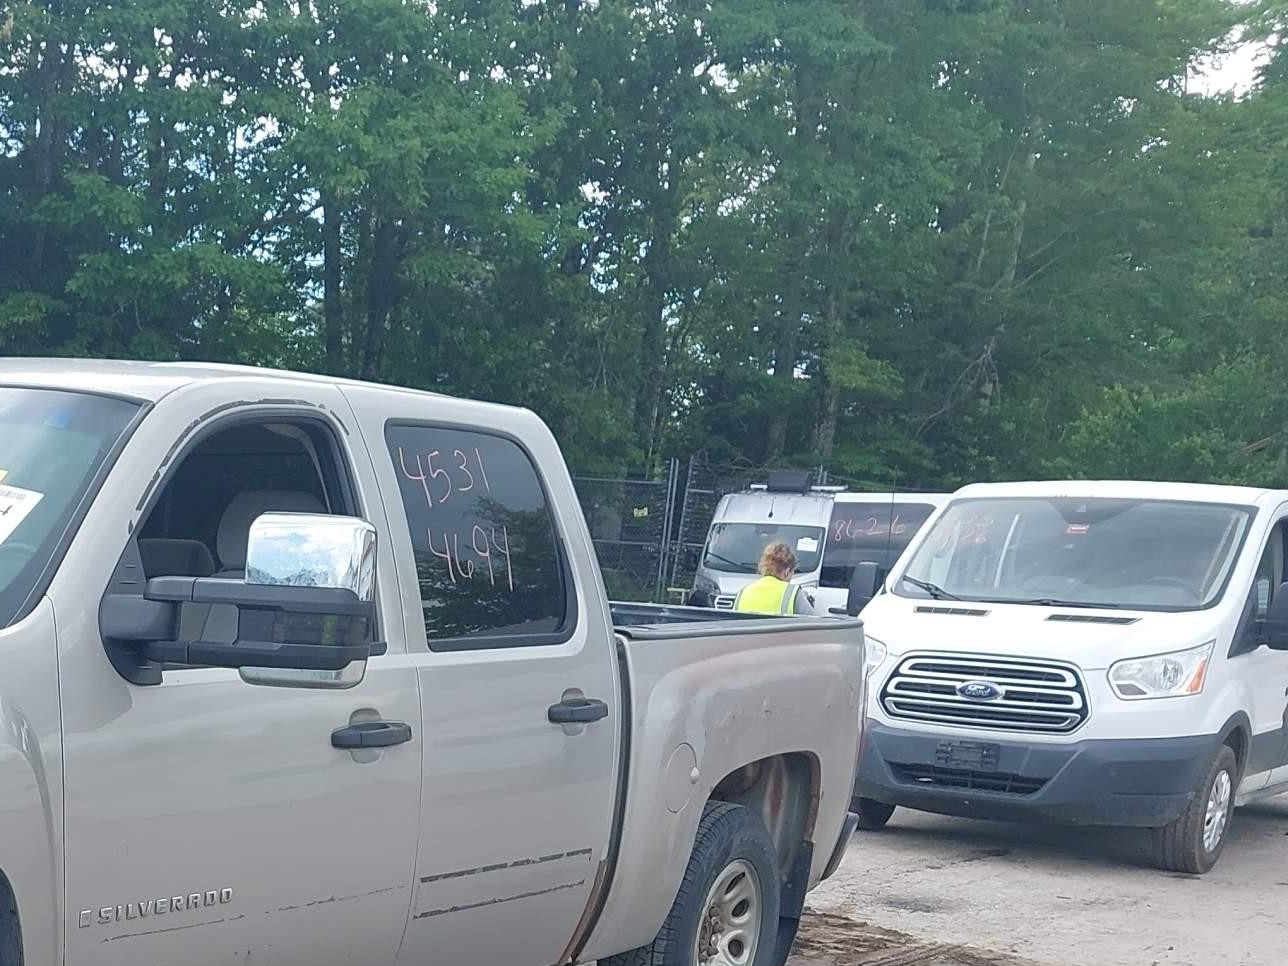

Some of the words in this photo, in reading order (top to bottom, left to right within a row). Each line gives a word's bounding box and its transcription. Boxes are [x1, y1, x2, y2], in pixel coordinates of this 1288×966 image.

[397, 446, 491, 508] 4531
[426, 524, 515, 593] 4694
[96, 886, 234, 925] SILVERADO
